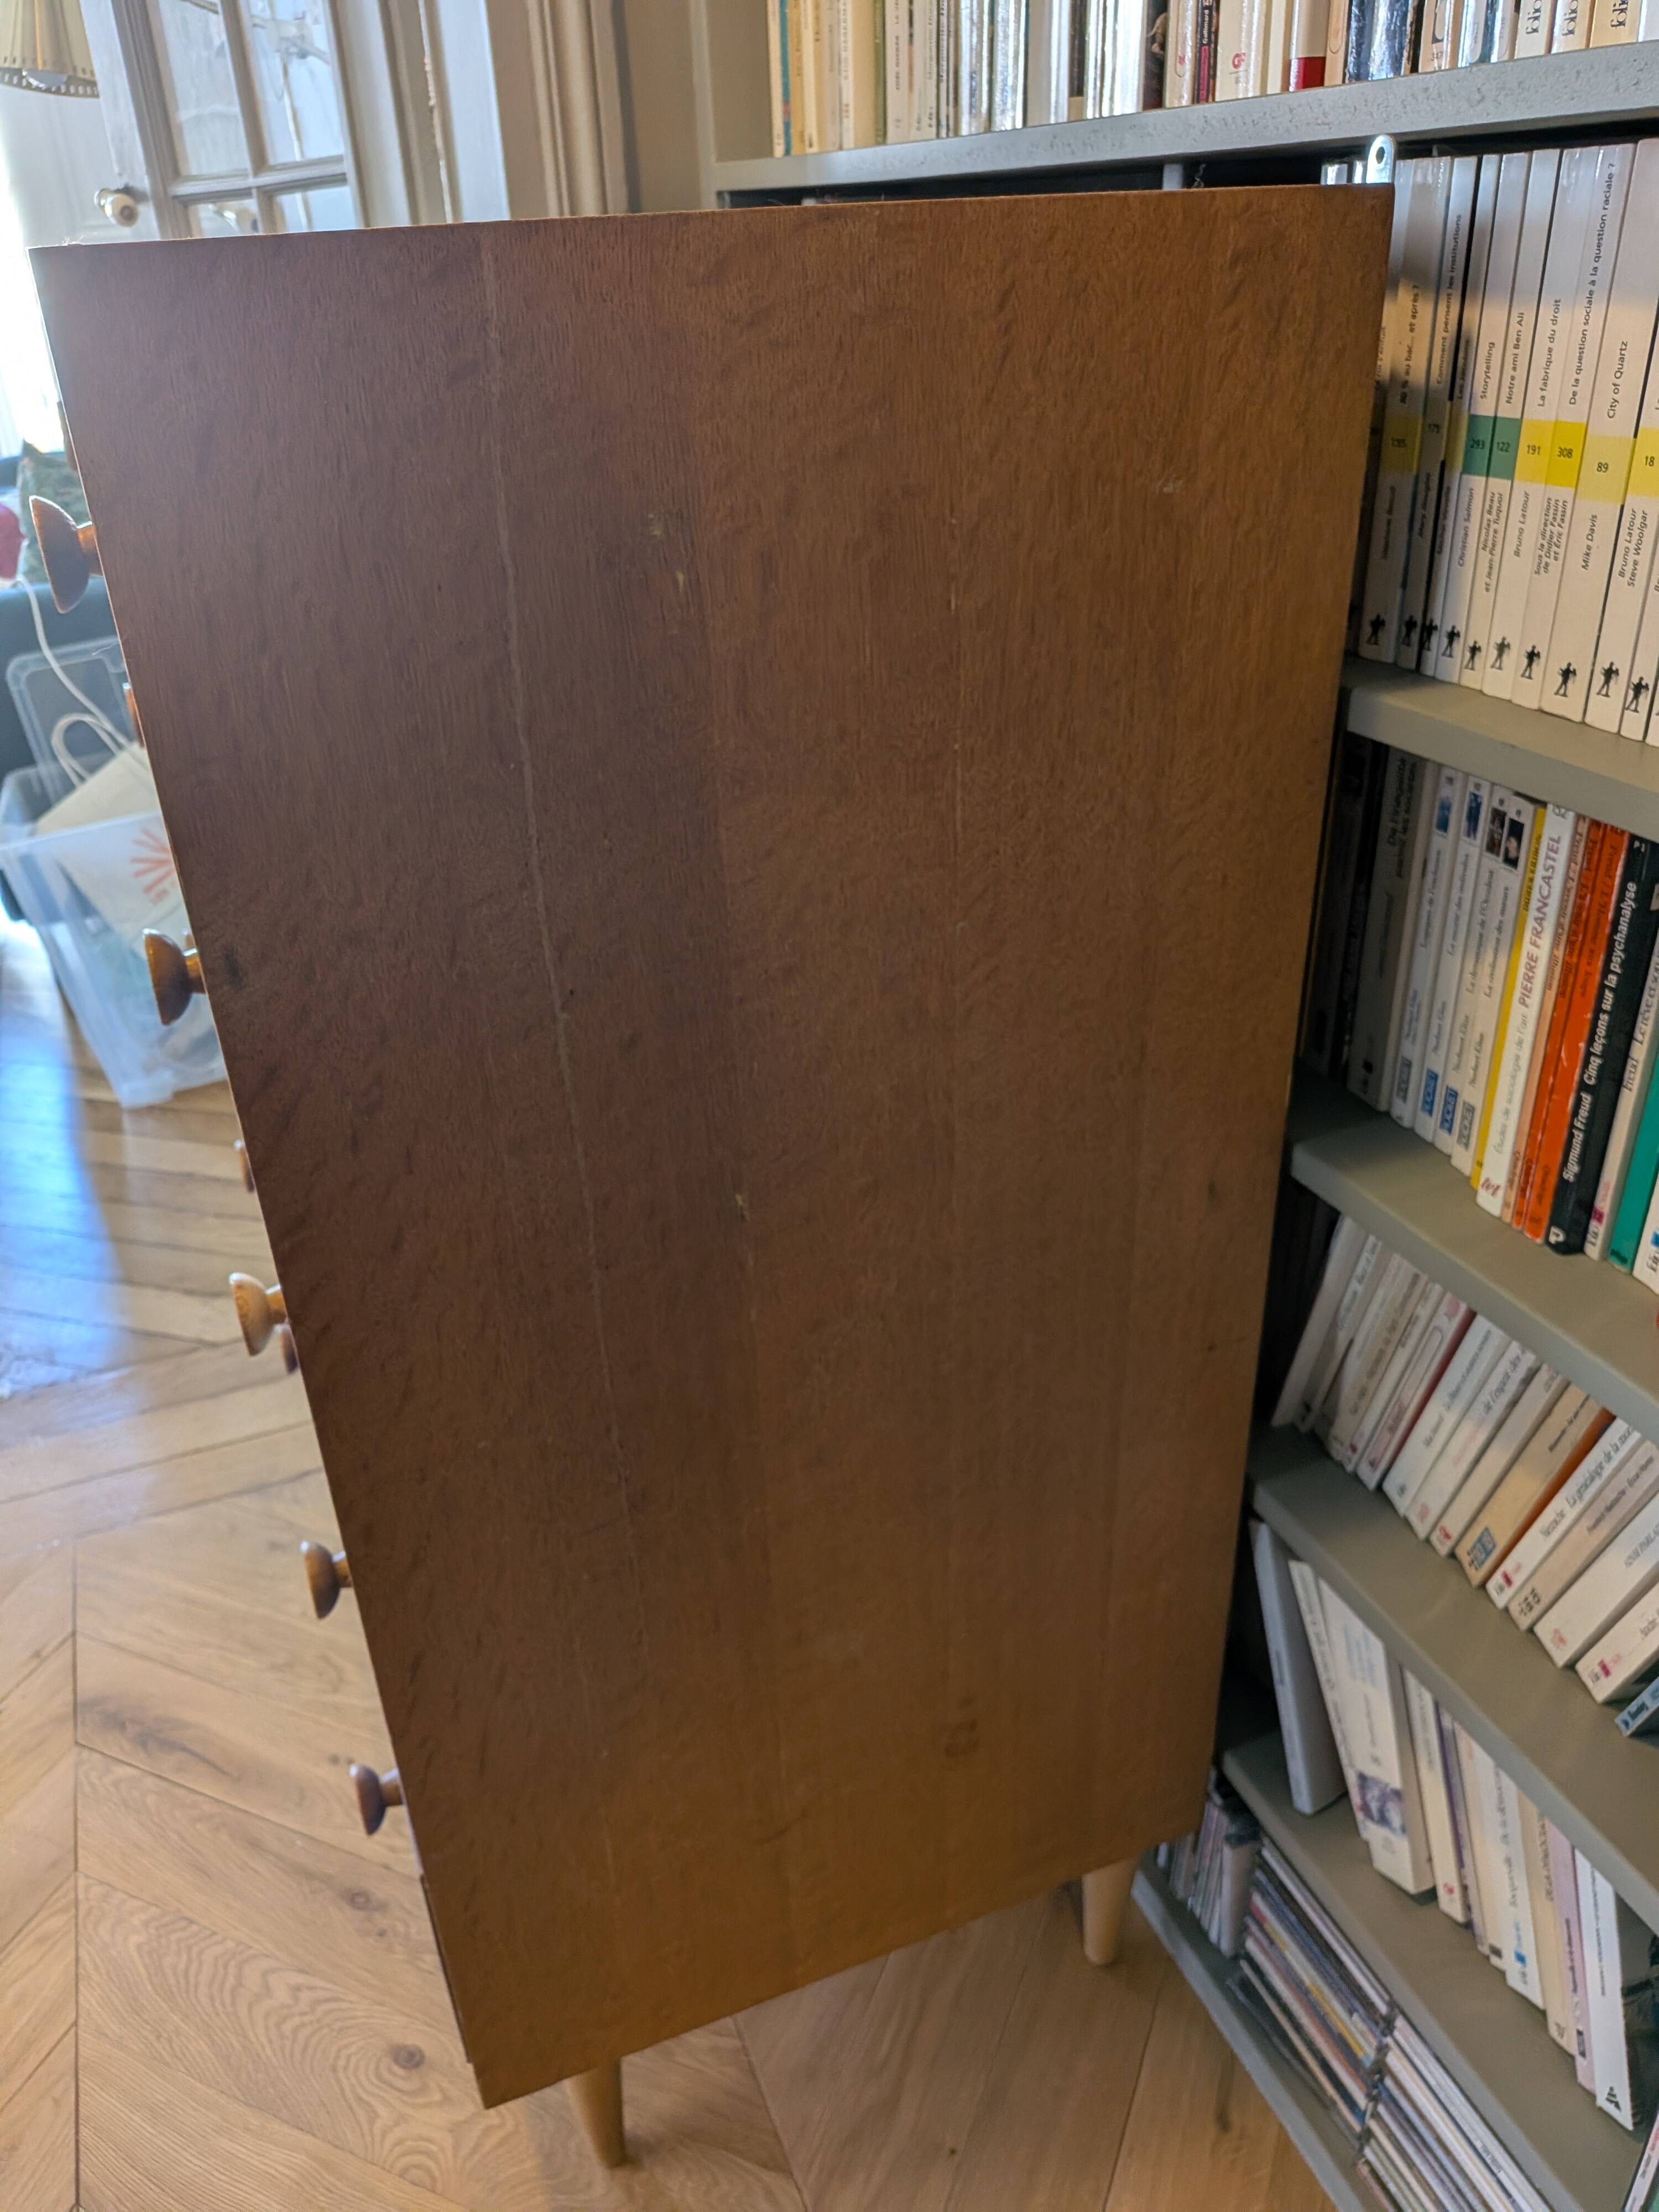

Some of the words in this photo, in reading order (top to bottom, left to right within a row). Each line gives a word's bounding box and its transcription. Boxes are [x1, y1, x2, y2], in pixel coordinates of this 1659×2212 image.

[1526, 0, 1542, 34] folio
[1561, 0, 1578, 36] folio
[1610, 0, 1629, 28] foli
[1601, 173, 1614, 211] raciale
[1448, 214, 1462, 273] institutions
[1592, 213, 1609, 264] question
[1587, 279, 1597, 287] à
[1589, 265, 1599, 277] la
[1515, 312, 1525, 327] Ali
[1550, 298, 1562, 326] droit
[1582, 289, 1595, 326] sociale
[1512, 329, 1522, 350] Ben
[1547, 329, 1557, 343] du
[1509, 353, 1519, 372] ami
[1573, 328, 1590, 375] question
[1614, 340, 1629, 380] Quartz
[1479, 342, 1496, 400] Storytelling
[1539, 346, 1555, 393] fabrique
[1572, 378, 1580, 388] la
[1505, 375, 1516, 404] Notre
[1537, 394, 1546, 408] La
[1569, 390, 1578, 405] De
[1610, 382, 1621, 395] of
[1606, 398, 1619, 420] City
[1496, 441, 1510, 452] 122
[1526, 445, 1541, 456] 191
[1557, 447, 1573, 459] 308
[1597, 461, 1609, 473] 89
[1645, 455, 1655, 467] 18
[1481, 519, 1491, 551] Nicolas
[1486, 492, 1495, 516] Beau
[1493, 492, 1503, 526] Tuquoi
[1539, 497, 1552, 541] direction
[1550, 499, 1560, 528] Fassin
[1557, 500, 1568, 529] Fassin
[1457, 526, 1469, 567] Christian
[1464, 487, 1474, 523] Salmon
[1513, 527, 1524, 557] Bruno
[1519, 491, 1530, 525] Latour
[1585, 514, 1598, 542] Davis
[1484, 528, 1498, 580] Jean-Pierre
[1537, 542, 1545, 552] la
[1543, 530, 1554, 559] Didier
[1552, 531, 1563, 549] Éric
[1618, 546, 1630, 578] Bruno
[1625, 508, 1637, 544] Latour
[1627, 559, 1639, 588] Steve
[1633, 510, 1650, 556] Woolgar
[1533, 554, 1543, 576] Sous
[1541, 561, 1550, 574] de
[1552, 551, 1560, 561] et
[1581, 544, 1592, 570] Mike
[1483, 581, 1491, 593] et
[1517, 951, 1538, 1008] PIERRE
[1529, 834, 1561, 949] FRANCASTEL
[1609, 881, 1639, 974] psychanalyse
[1604, 973, 1619, 988] la
[1601, 988, 1616, 1012] sur
[1589, 1012, 1609, 1056] leçons
[1583, 1055, 1604, 1086] Cinq
[1573, 1092, 1593, 1130] Freud
[1562, 1129, 1585, 1183] Sigmund
